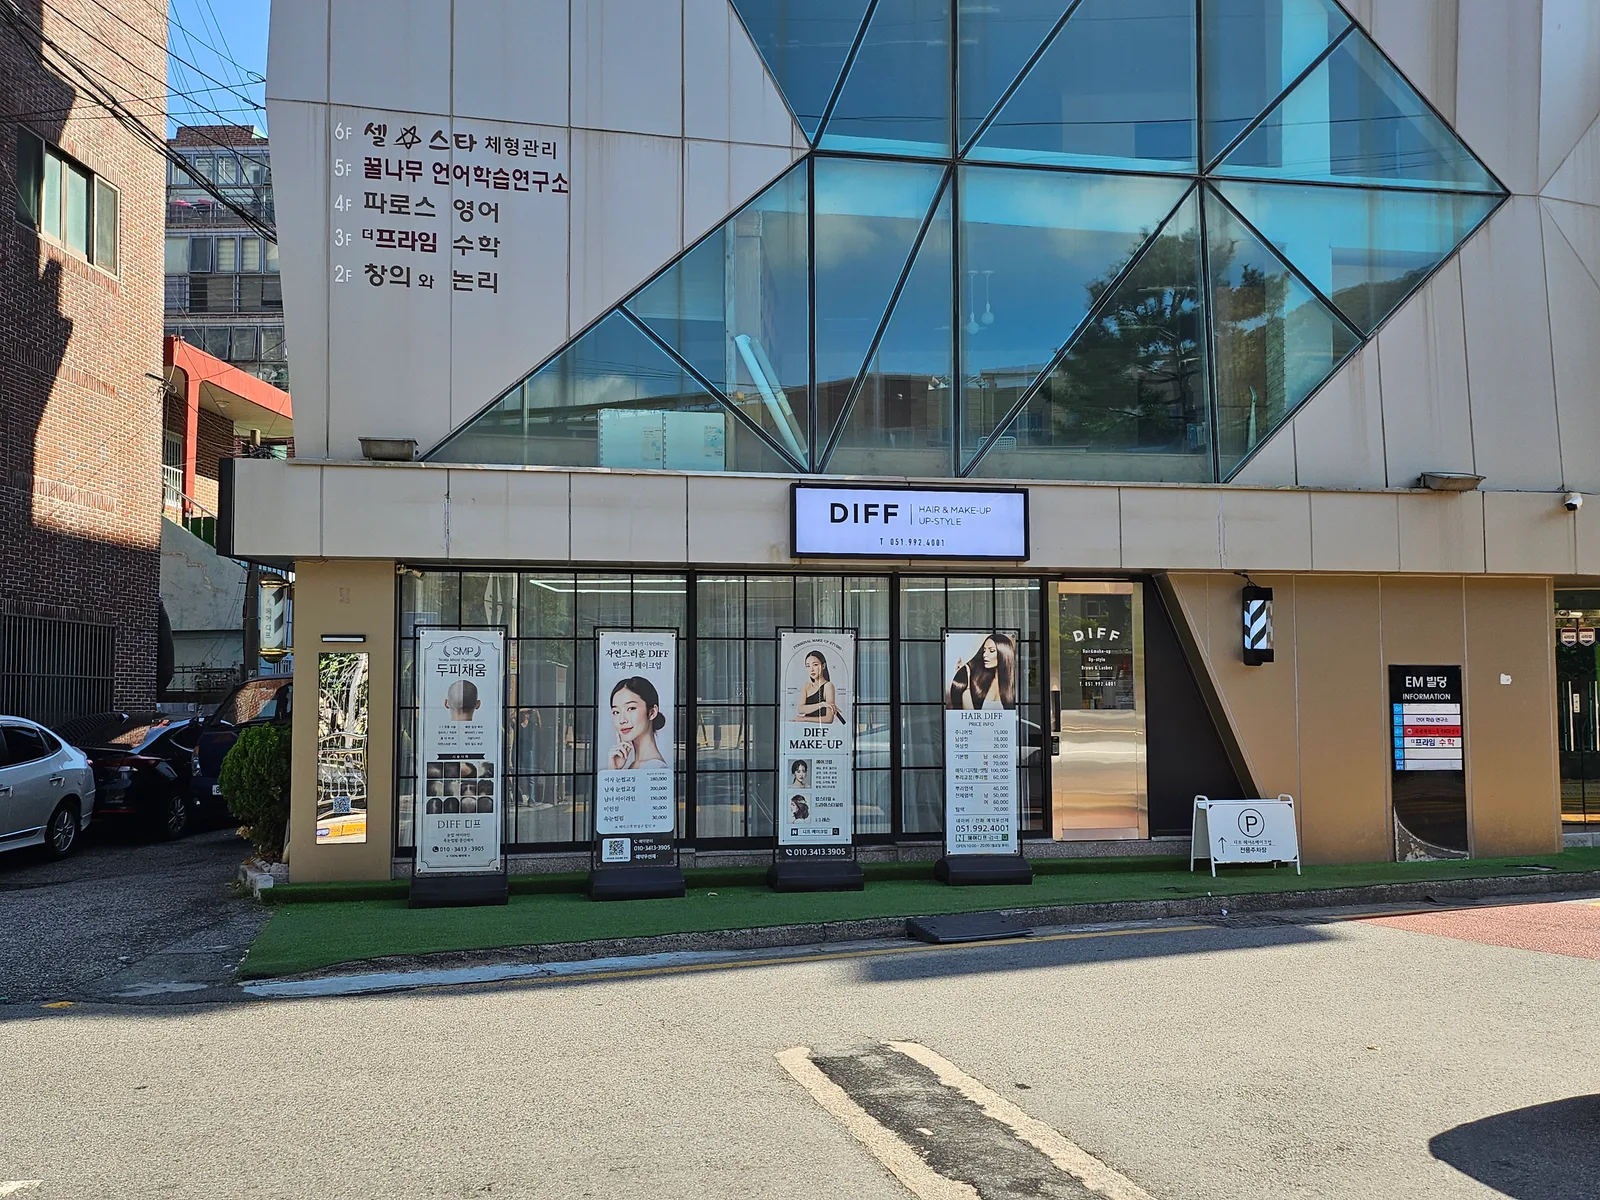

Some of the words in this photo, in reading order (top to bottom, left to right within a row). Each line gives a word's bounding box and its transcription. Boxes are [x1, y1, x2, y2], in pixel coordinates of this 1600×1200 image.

[334, 122, 352, 140] 6F
[485, 135, 557, 160] 체형관리
[334, 159, 352, 177] 5F
[364, 156, 423, 183] 꿀나무
[432, 161, 569, 194] 언어학습연구소
[334, 194, 352, 212] 4F
[364, 191, 436, 218] 파로스
[453, 198, 499, 224] 영어
[334, 229, 352, 247] 3F
[453, 234, 500, 258] 수학
[334, 264, 352, 283] 2F
[364, 263, 411, 288] 창의
[418, 273, 435, 289] 와
[453, 269, 498, 294] 논리
[830, 502, 899, 524] DIFF
[919, 505, 940, 514] HAIR
[943, 505, 949, 514] &
[950, 506, 992, 515] MAKE-UP
[919, 517, 962, 526] UP-STYLE
[880, 537, 884, 546] T
[890, 538, 945, 547] 051.992.4001
[1073, 627, 1120, 642] DIFF
[452, 646, 474, 656] SMP
[605, 649, 646, 658] 자연스러운
[648, 649, 670, 658] DIFF
[436, 663, 487, 677] 두피채움
[613, 661, 633, 669] 반영구
[635, 661, 661, 670] 메이크업
[1405, 676, 1424, 688] EM
[1427, 676, 1447, 688] 빌딩
[804, 728, 829, 737] DIFF
[789, 740, 843, 749] MAKE-UP
[437, 820, 461, 829] DIFF
[465, 819, 481, 828] 디프
[1245, 816, 1257, 832] P
[794, 848, 846, 856] 010.3413.3905
